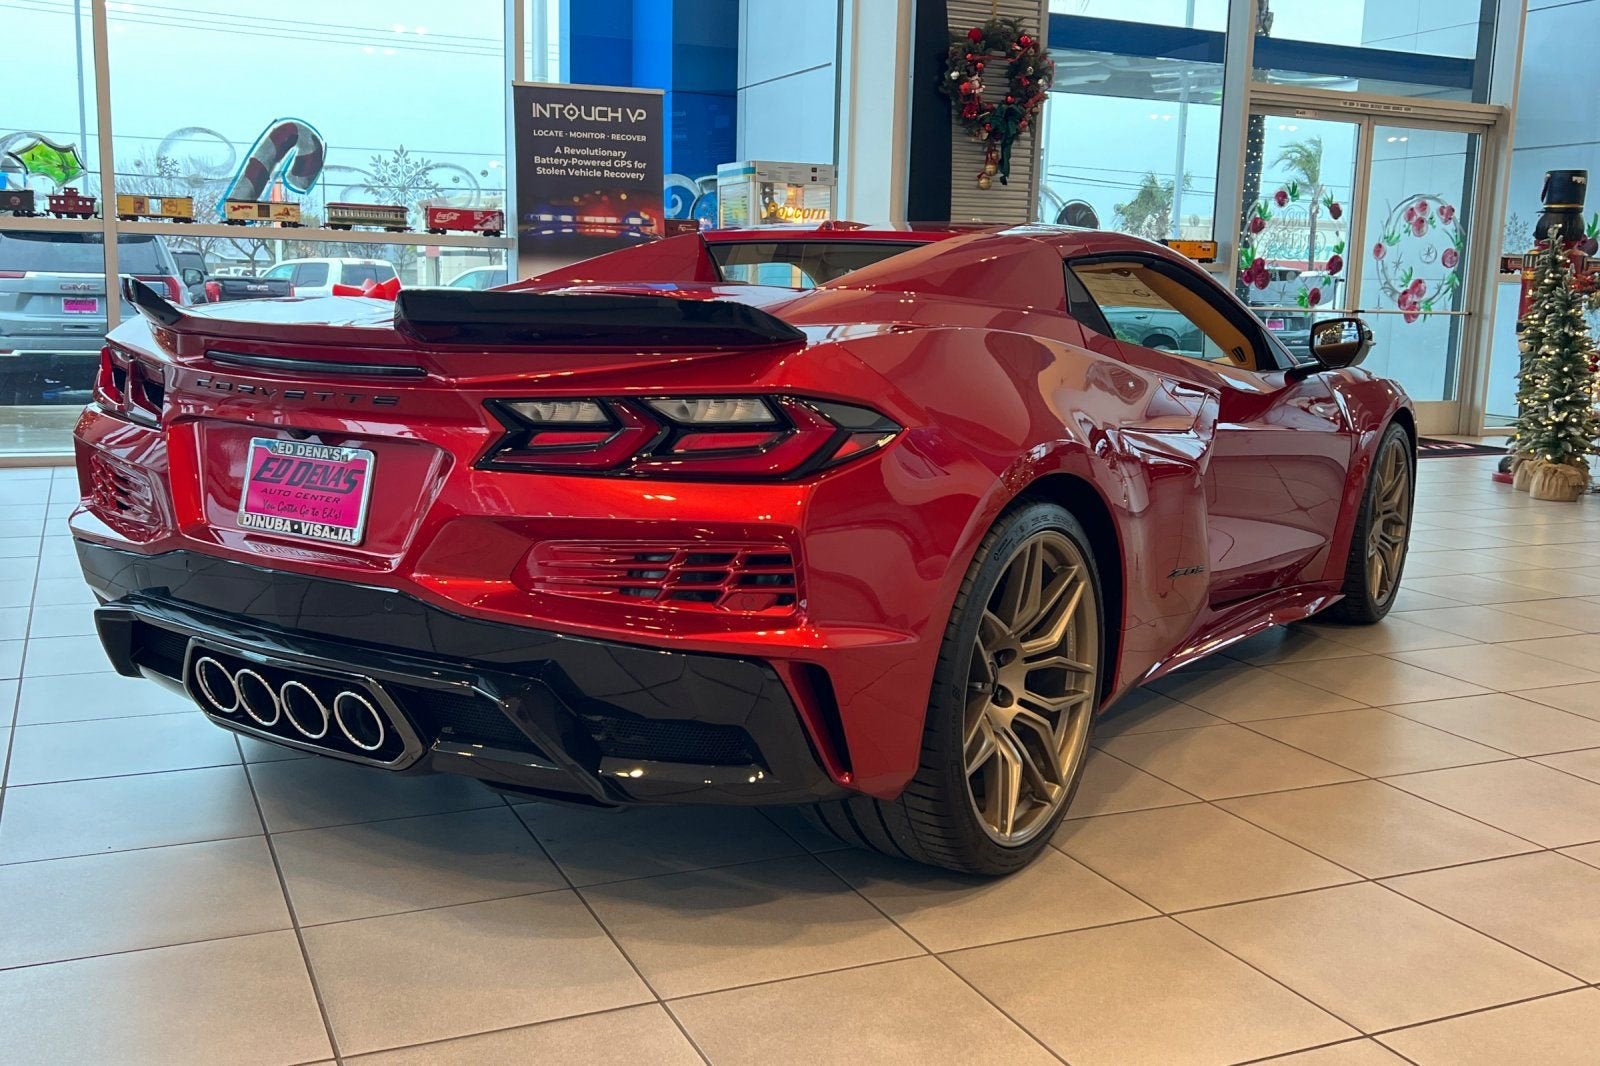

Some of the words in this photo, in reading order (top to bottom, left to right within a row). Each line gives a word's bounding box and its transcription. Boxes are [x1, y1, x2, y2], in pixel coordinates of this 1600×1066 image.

[532, 102, 622, 122] INTOUCH
[533, 129, 564, 138] LOCATE
[569, 131, 606, 140] MONITOR
[611, 133, 647, 142] RECOVER
[554, 146, 562, 154] A
[563, 146, 627, 159] Revolutionary
[534, 155, 612, 168] Battery-Powered
[613, 159, 633, 169] GPS
[633, 160, 647, 170] for
[536, 166, 567, 176] Stolen
[568, 168, 602, 178] Vehicle
[603, 169, 645, 181] Recovery
[767, 202, 827, 220] Popcorn
[60, 283, 99, 291] GMC
[197, 378, 399, 405] CORVETTE
[277, 443, 294, 456] ED
[296, 445, 341, 462] DENA'S
[252, 456, 291, 483] ED
[261, 487, 292, 497] AUTO
[294, 492, 341, 504] CENTER
[242, 513, 292, 532] DINUBA
[300, 522, 353, 542] VISALIA
